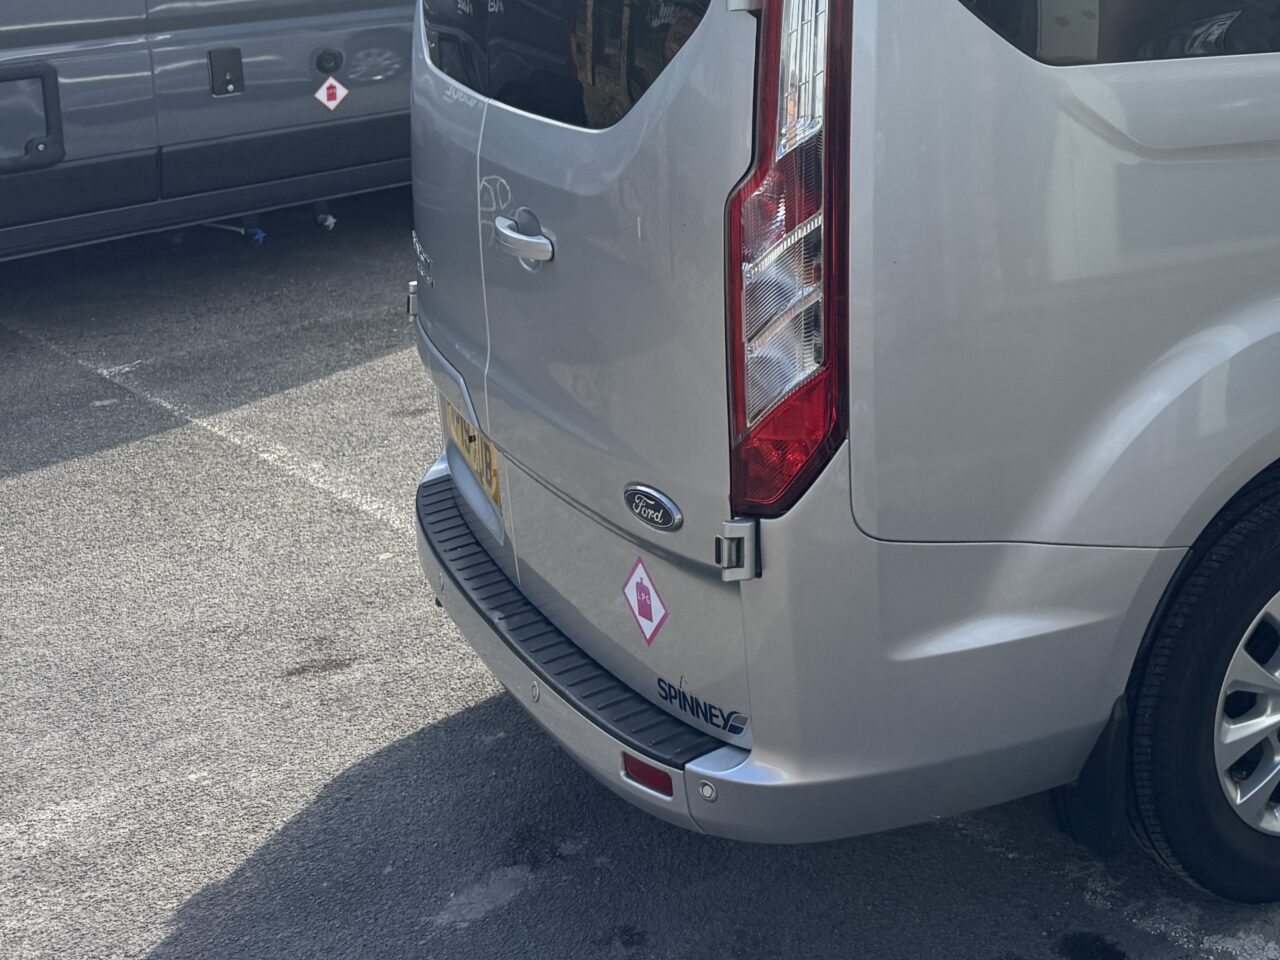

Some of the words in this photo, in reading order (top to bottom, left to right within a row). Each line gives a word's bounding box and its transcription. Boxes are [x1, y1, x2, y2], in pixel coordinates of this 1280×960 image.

[632, 494, 664, 523] Ford
[637, 591, 651, 604] LPG
[657, 677, 742, 731] SPINNEY
